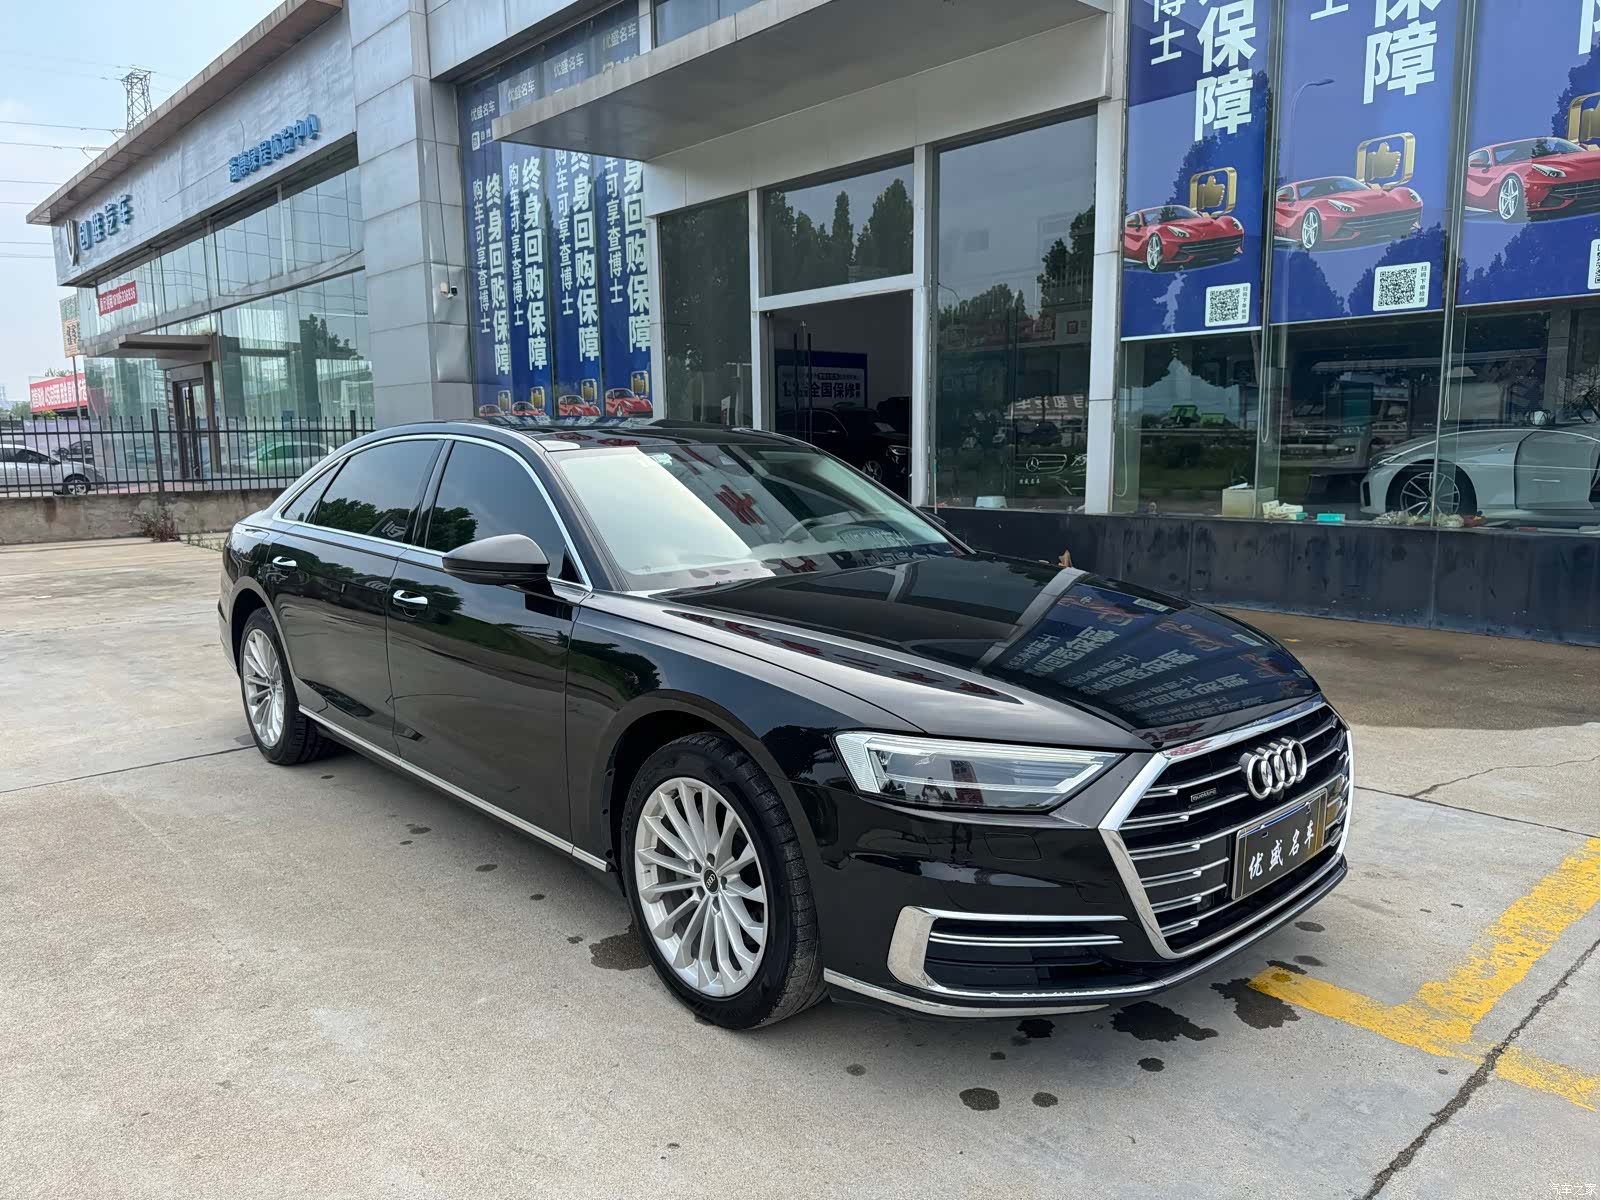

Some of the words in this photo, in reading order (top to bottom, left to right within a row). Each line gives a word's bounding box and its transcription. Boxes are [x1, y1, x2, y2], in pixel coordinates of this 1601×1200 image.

[1194, 0, 1256, 141] 保障
[473, 178, 490, 333] 购车可享查博士
[486, 172, 512, 376] 终身回购保障
[508, 162, 524, 326] 购车可享查博士
[522, 154, 547, 371] 终身回购保障
